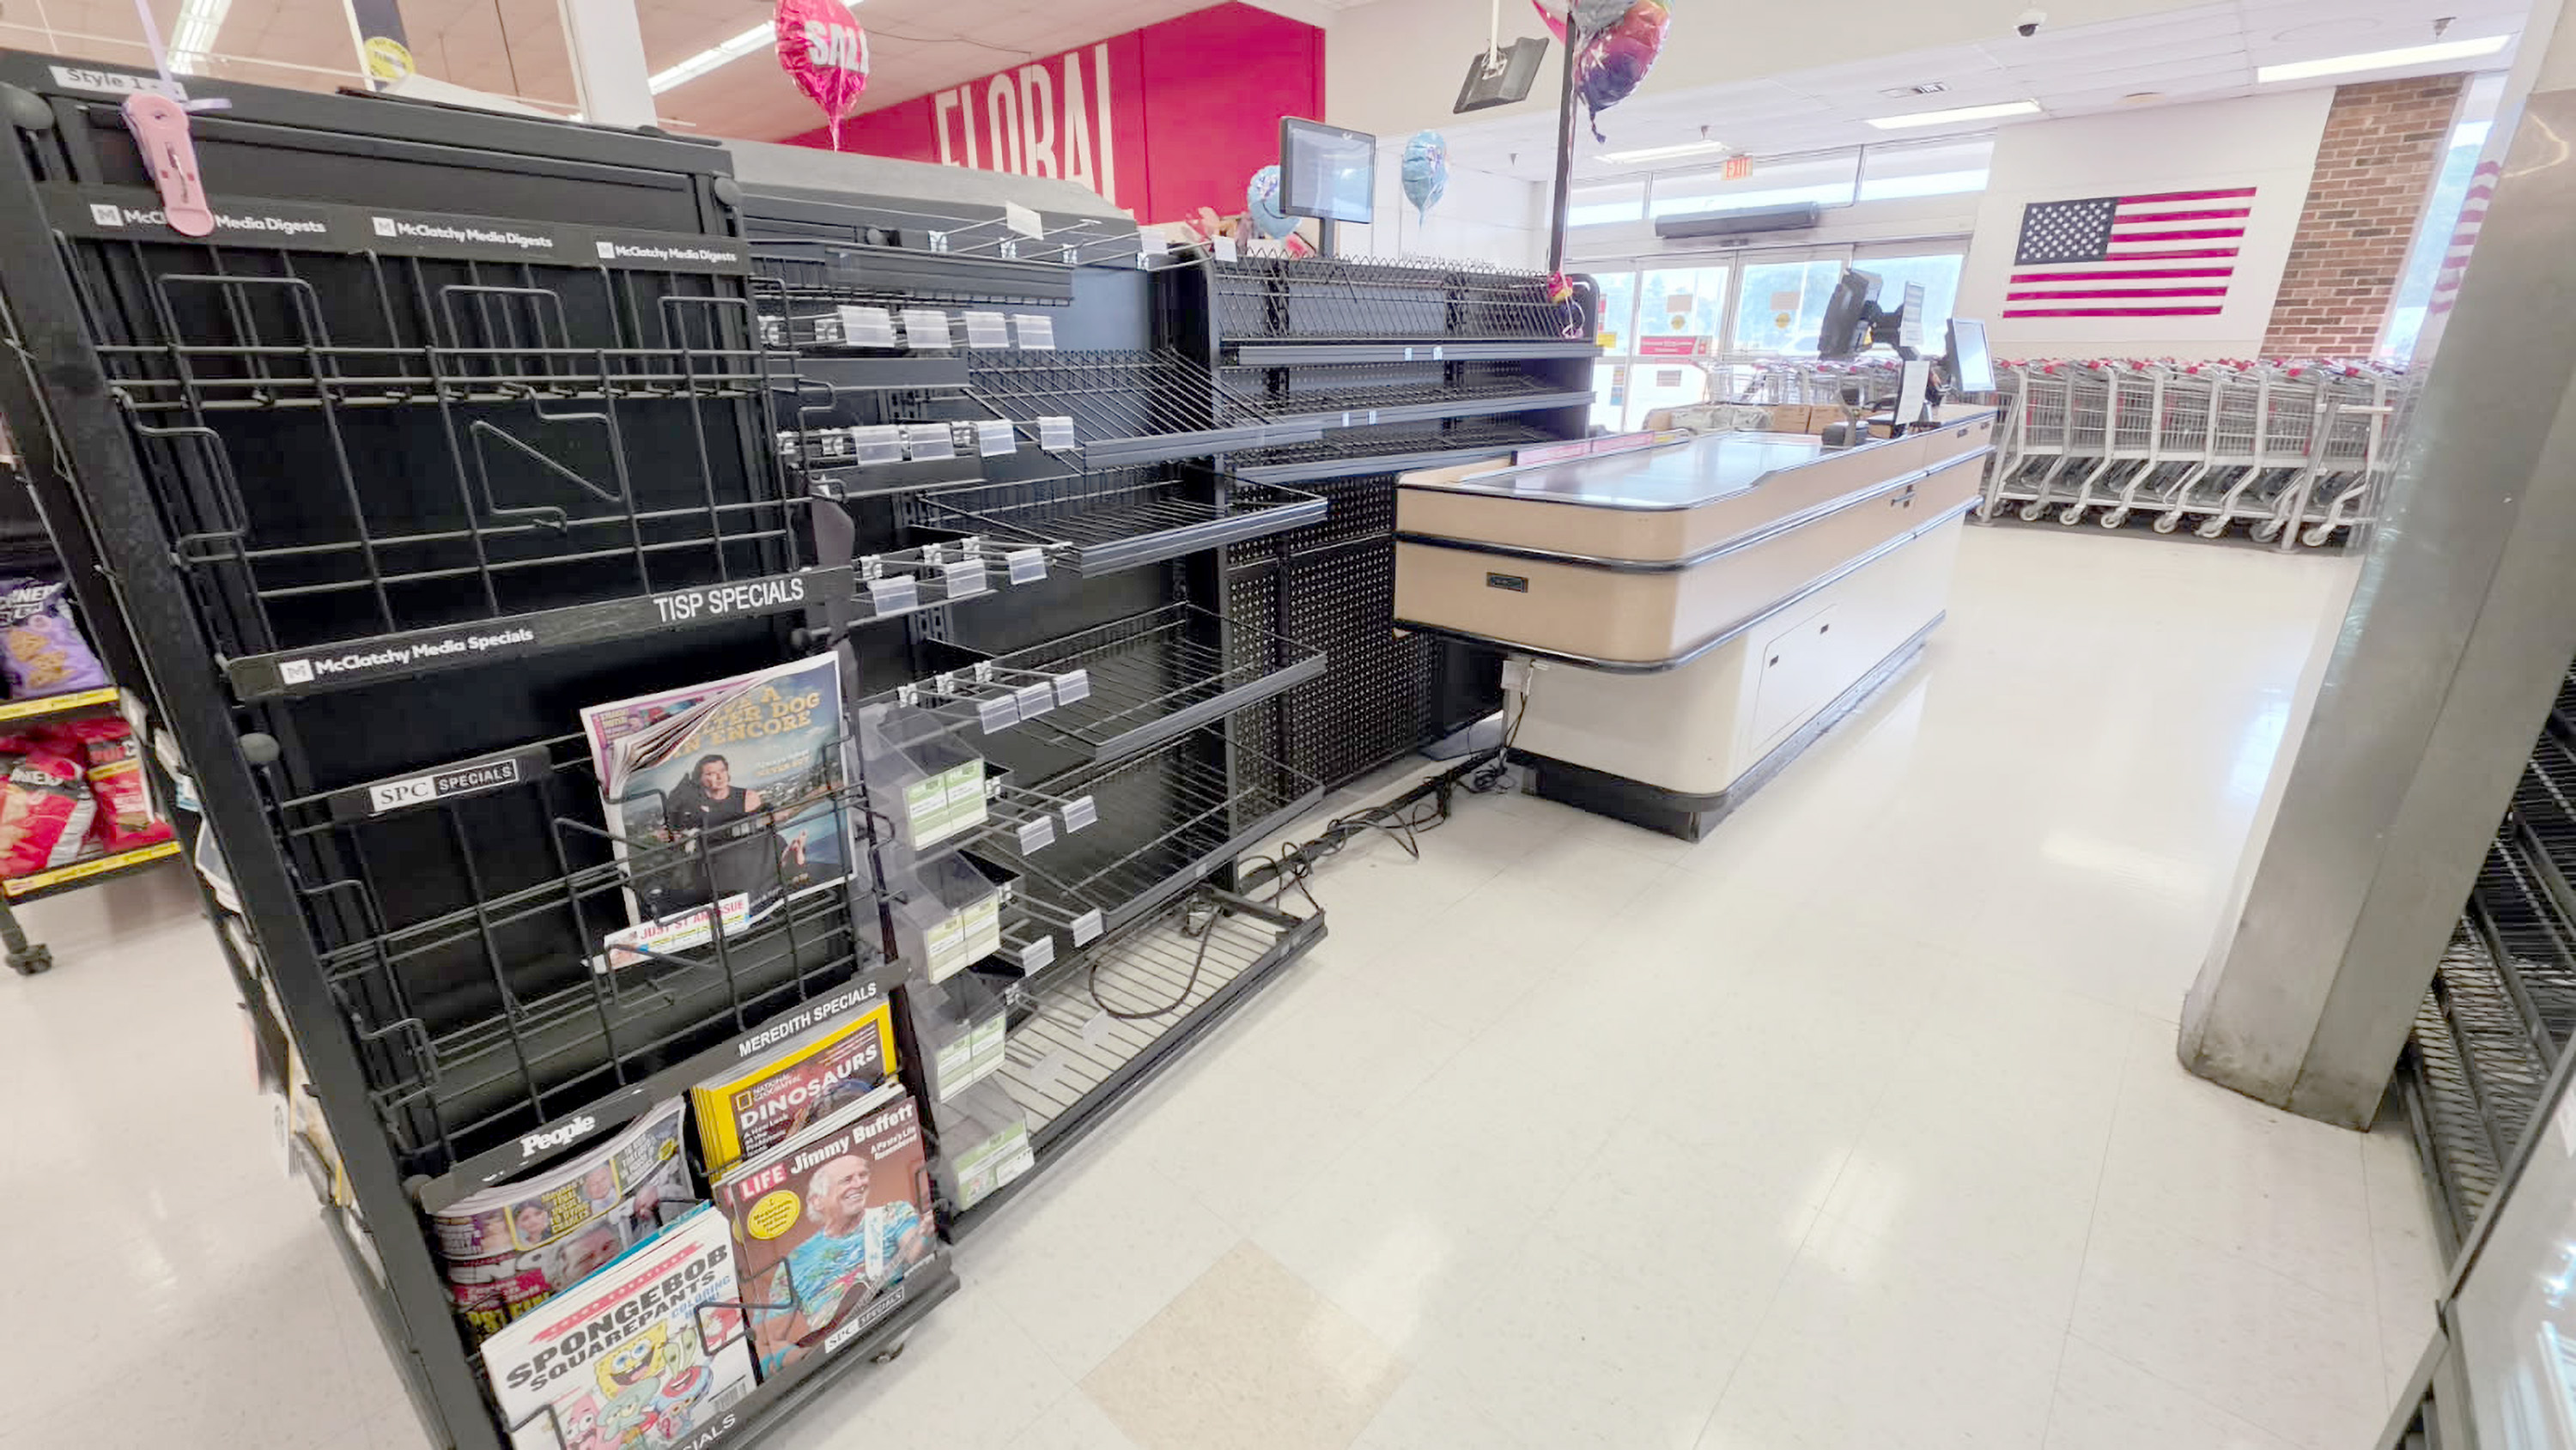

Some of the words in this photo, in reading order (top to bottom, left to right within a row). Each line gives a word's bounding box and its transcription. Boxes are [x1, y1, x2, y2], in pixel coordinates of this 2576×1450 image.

[67, 69, 124, 87] Style
[1726, 157, 1751, 179] EXIT
[215, 215, 267, 230] Media
[266, 216, 326, 235] Digests
[398, 222, 465, 242] McClatchy
[466, 228, 506, 243] Media
[507, 232, 553, 248] Digests
[616, 245, 668, 261] McClatchy
[669, 248, 699, 260] Media
[699, 250, 737, 263] Digests
[653, 592, 703, 622] TISP
[708, 578, 804, 614] SPECIALS
[314, 648, 410, 674] McClatchy
[411, 640, 465, 659] Media
[467, 628, 534, 651] Specials
[771, 692, 821, 719] DOG
[711, 710, 812, 746] ENCORE
[381, 782, 428, 804] SPC
[438, 766, 513, 792] SPECIALS
[738, 1011, 811, 1058] MEREDITH
[814, 981, 877, 1021] SPECIALS
[740, 1043, 878, 1130] DINOSAURS
[519, 1115, 596, 1157] People
[742, 1167, 786, 1198] LIFE
[791, 1136, 849, 1174] Jimmy
[852, 1104, 913, 1144] Buffett
[507, 1244, 728, 1389] SPONGEBOB
[530, 1271, 715, 1392] SQUAREPANTS
